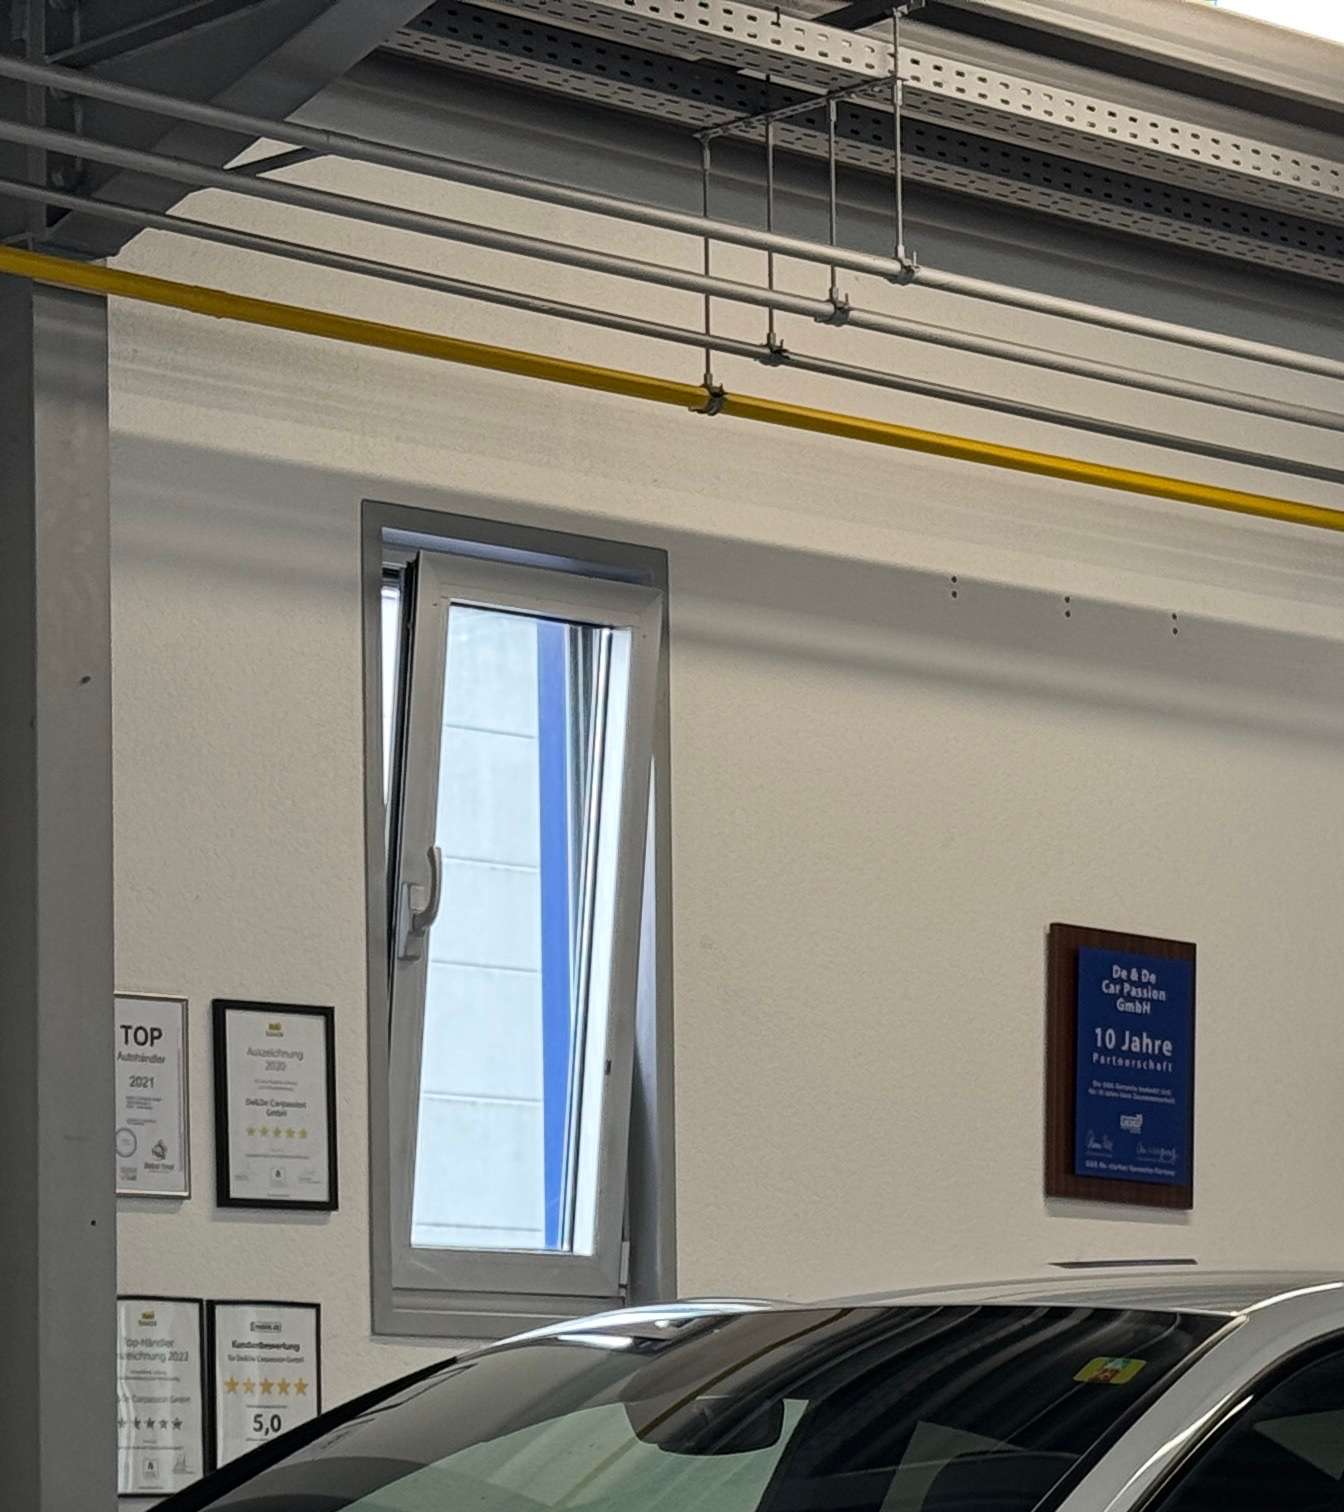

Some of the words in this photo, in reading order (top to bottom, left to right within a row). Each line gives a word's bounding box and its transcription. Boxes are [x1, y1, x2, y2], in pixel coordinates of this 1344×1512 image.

[1112, 964, 1128, 980] De
[1130, 967, 1139, 981] &
[1141, 969, 1157, 984] De
[1102, 979, 1122, 994] Car
[1123, 983, 1167, 1001] Passion
[1116, 998, 1152, 1014] GmbH
[119, 1024, 164, 1047] TOP
[1095, 1027, 1116, 1050] 10
[1121, 1030, 1173, 1056] Jahre
[1092, 1052, 1173, 1073] Partnerschaft
[129, 1075, 155, 1089] 2021
[253, 1413, 282, 1437] 5,0
